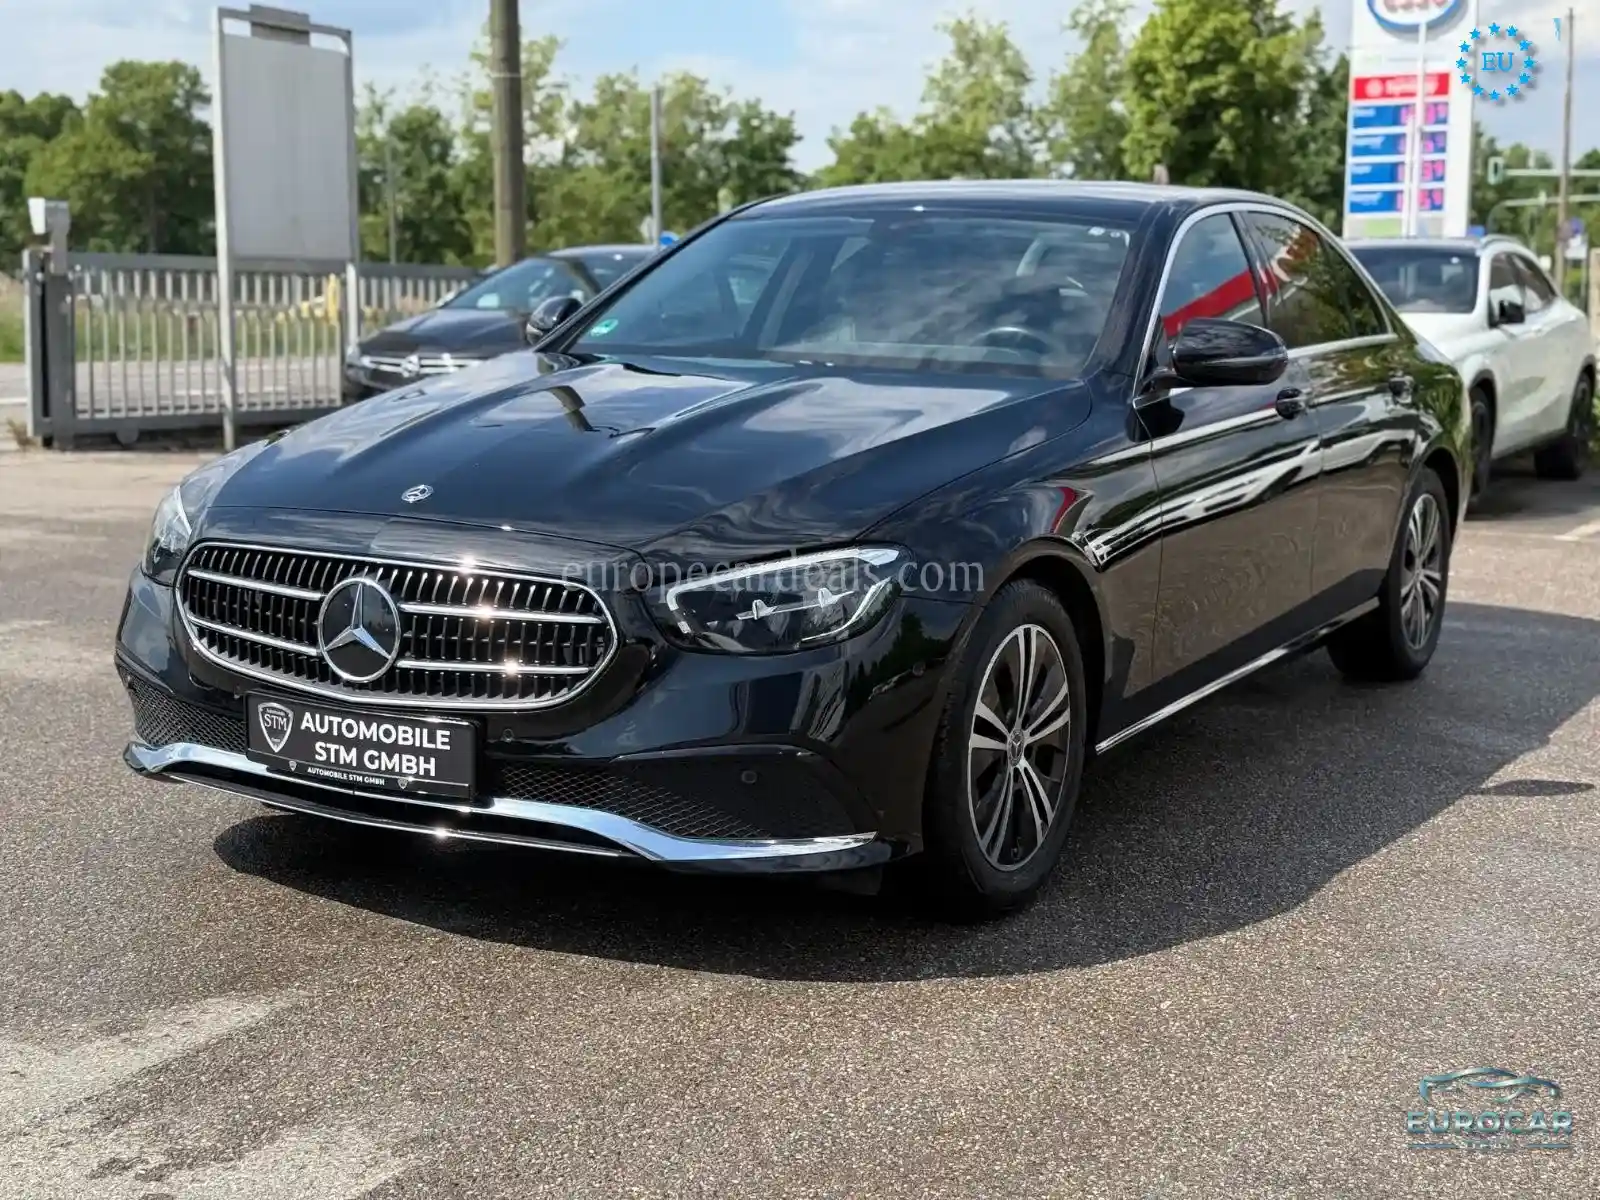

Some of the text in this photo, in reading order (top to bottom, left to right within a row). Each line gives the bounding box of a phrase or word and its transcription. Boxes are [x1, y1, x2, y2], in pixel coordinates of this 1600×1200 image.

[264, 713, 287, 731] STM
[300, 711, 451, 750] AUTOMOBILE
[315, 741, 436, 777] STM GMBH
[307, 767, 385, 786] AUTOMOBILE STM GMBH
